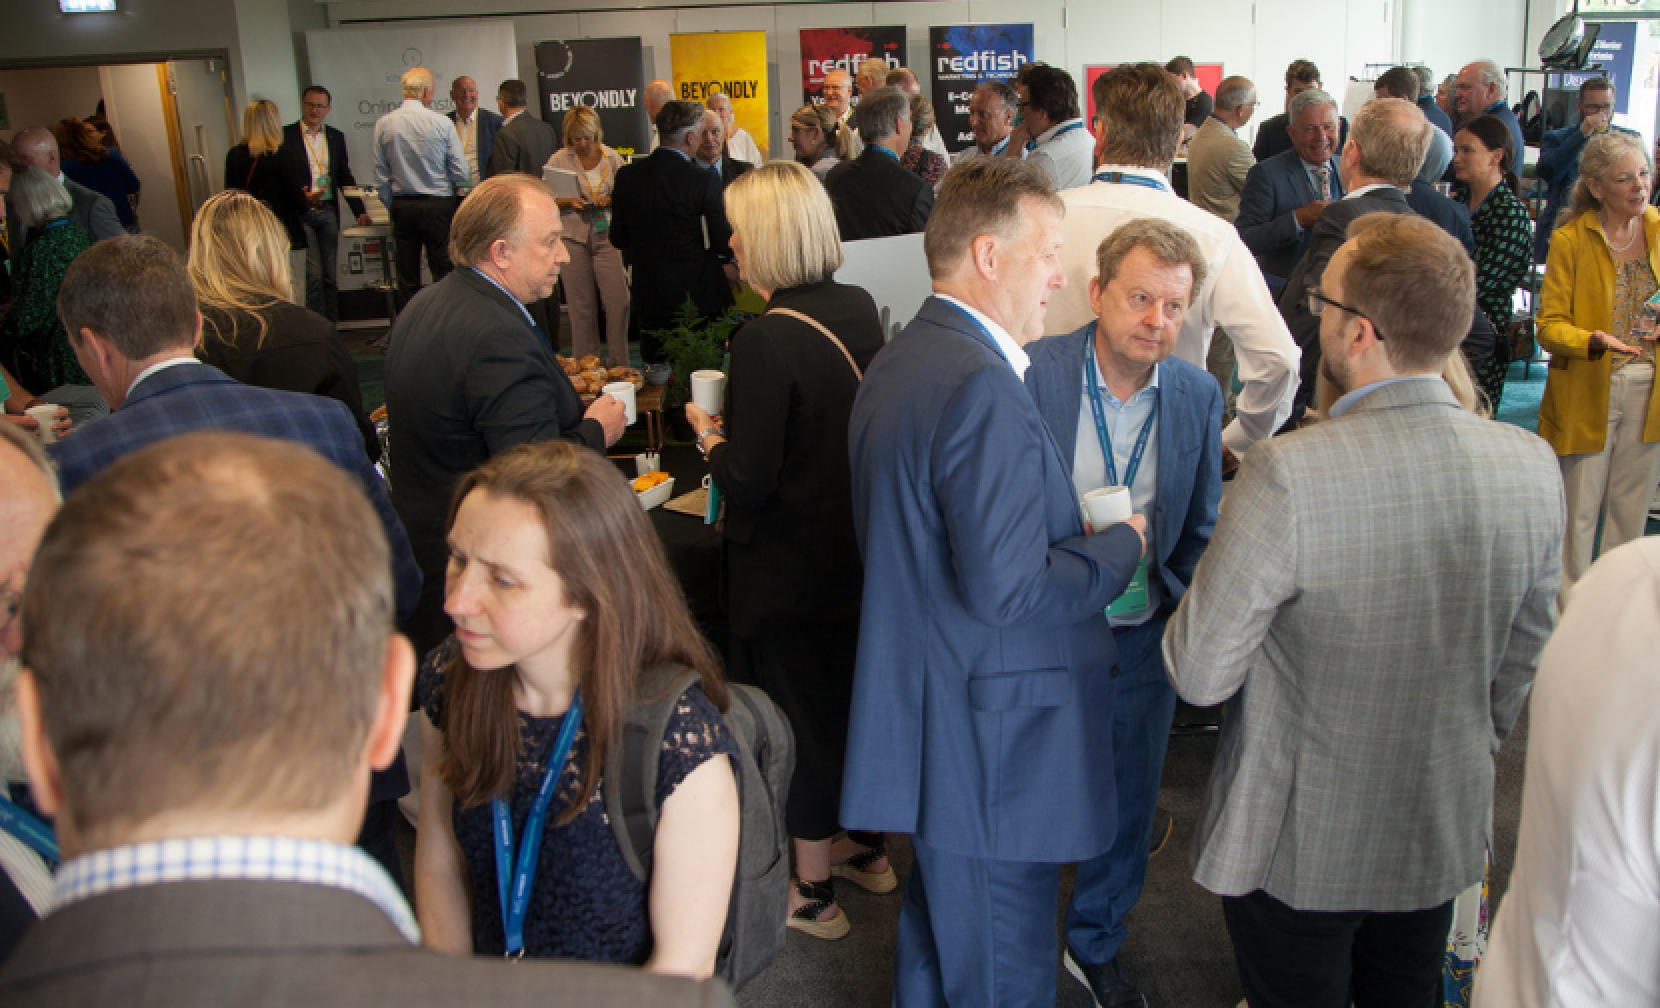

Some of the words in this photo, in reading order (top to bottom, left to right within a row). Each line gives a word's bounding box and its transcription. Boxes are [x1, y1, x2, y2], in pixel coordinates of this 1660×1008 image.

[808, 52, 900, 76] redfh
[937, 50, 1026, 72] redfish
[549, 88, 637, 112] BEYONDLY
[680, 80, 759, 99] BEYONDLY
